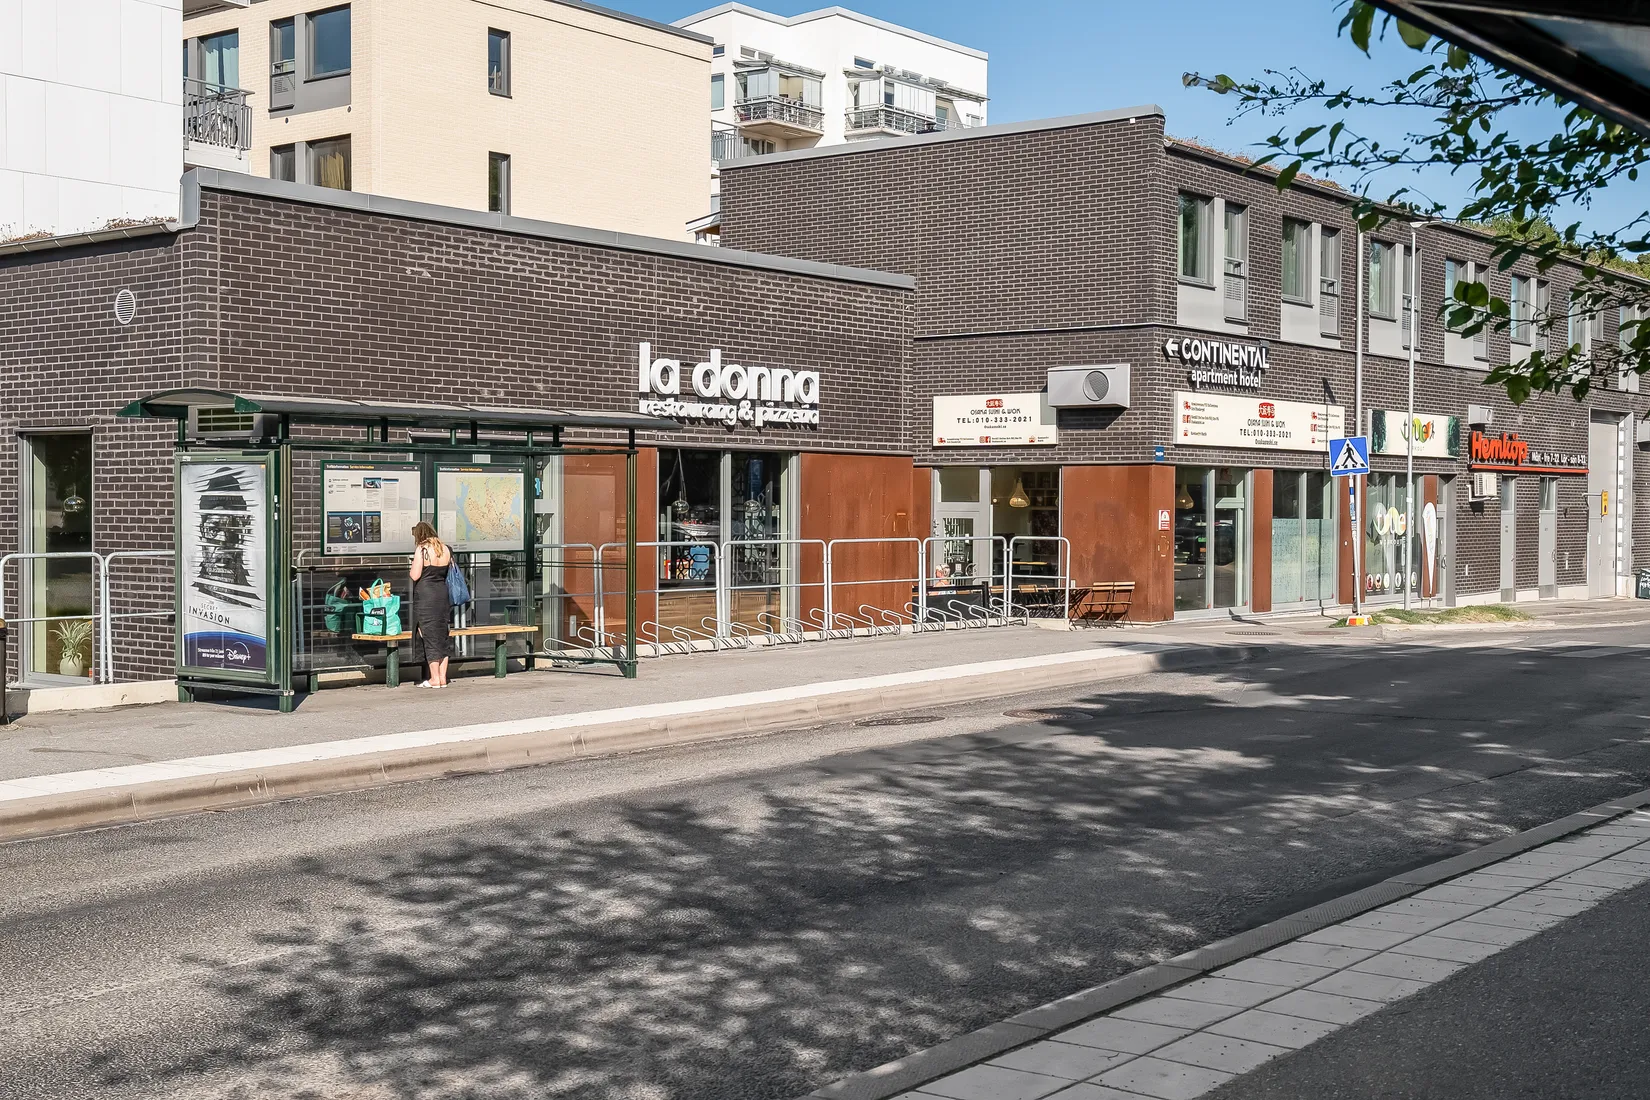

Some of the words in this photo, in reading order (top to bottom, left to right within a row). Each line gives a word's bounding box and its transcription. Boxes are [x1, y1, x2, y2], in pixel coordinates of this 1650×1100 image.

[1181, 338, 1269, 369] CONTINENTAL
[639, 341, 681, 395] la
[691, 349, 820, 404] donna
[1191, 368, 1238, 388] apartment
[1239, 368, 1261, 388] hotel
[1472, 430, 1528, 464] Hemköp
[188, 605, 230, 625] INVASION
[225, 647, 251, 664] Disney+
